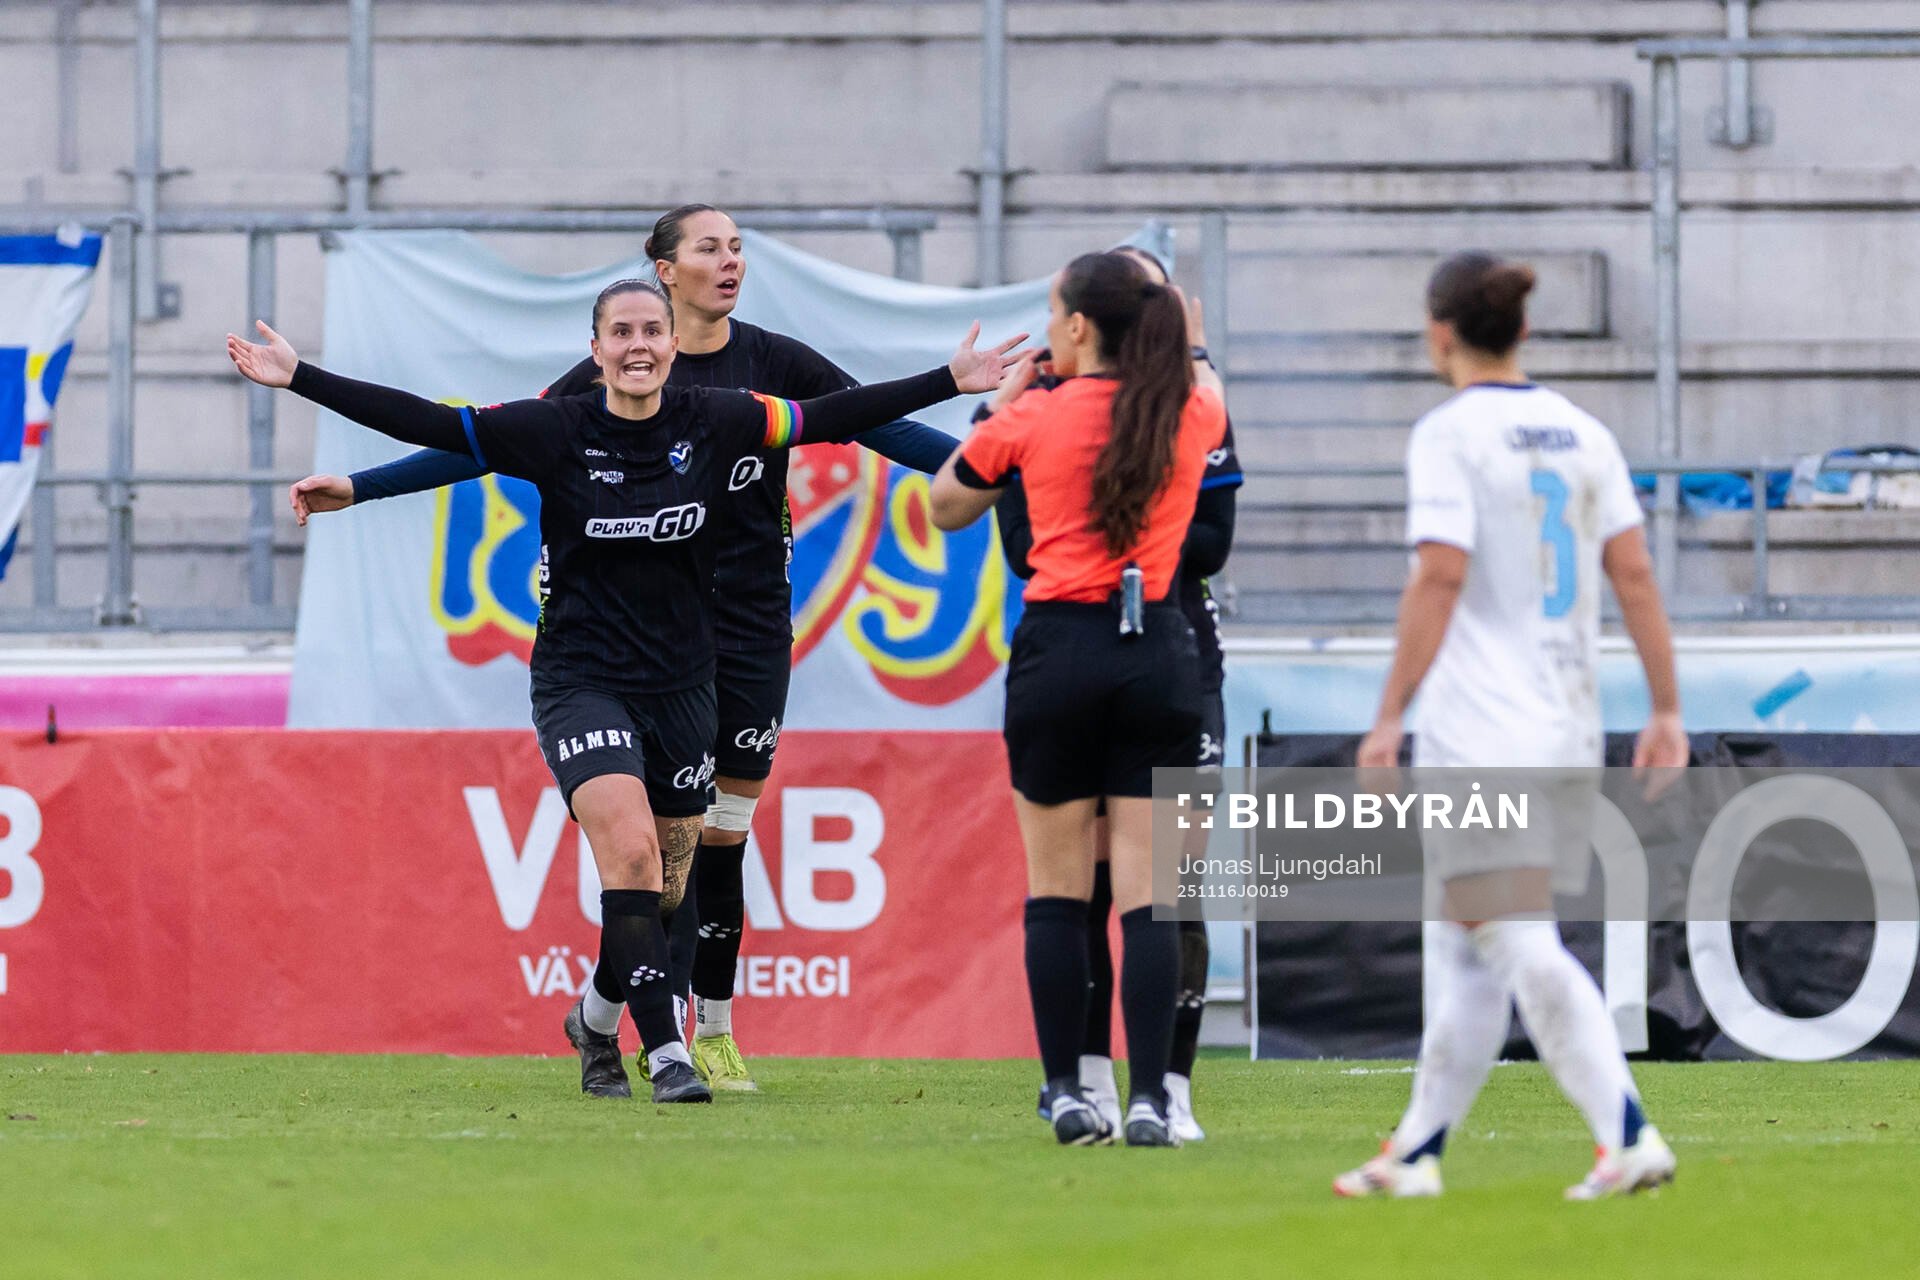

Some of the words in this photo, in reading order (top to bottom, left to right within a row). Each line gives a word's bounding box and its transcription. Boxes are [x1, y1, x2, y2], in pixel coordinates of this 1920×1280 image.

[653, 504, 699, 540] GO
[1529, 468, 1577, 618] 3
[558, 729, 632, 762] ÄLMBY
